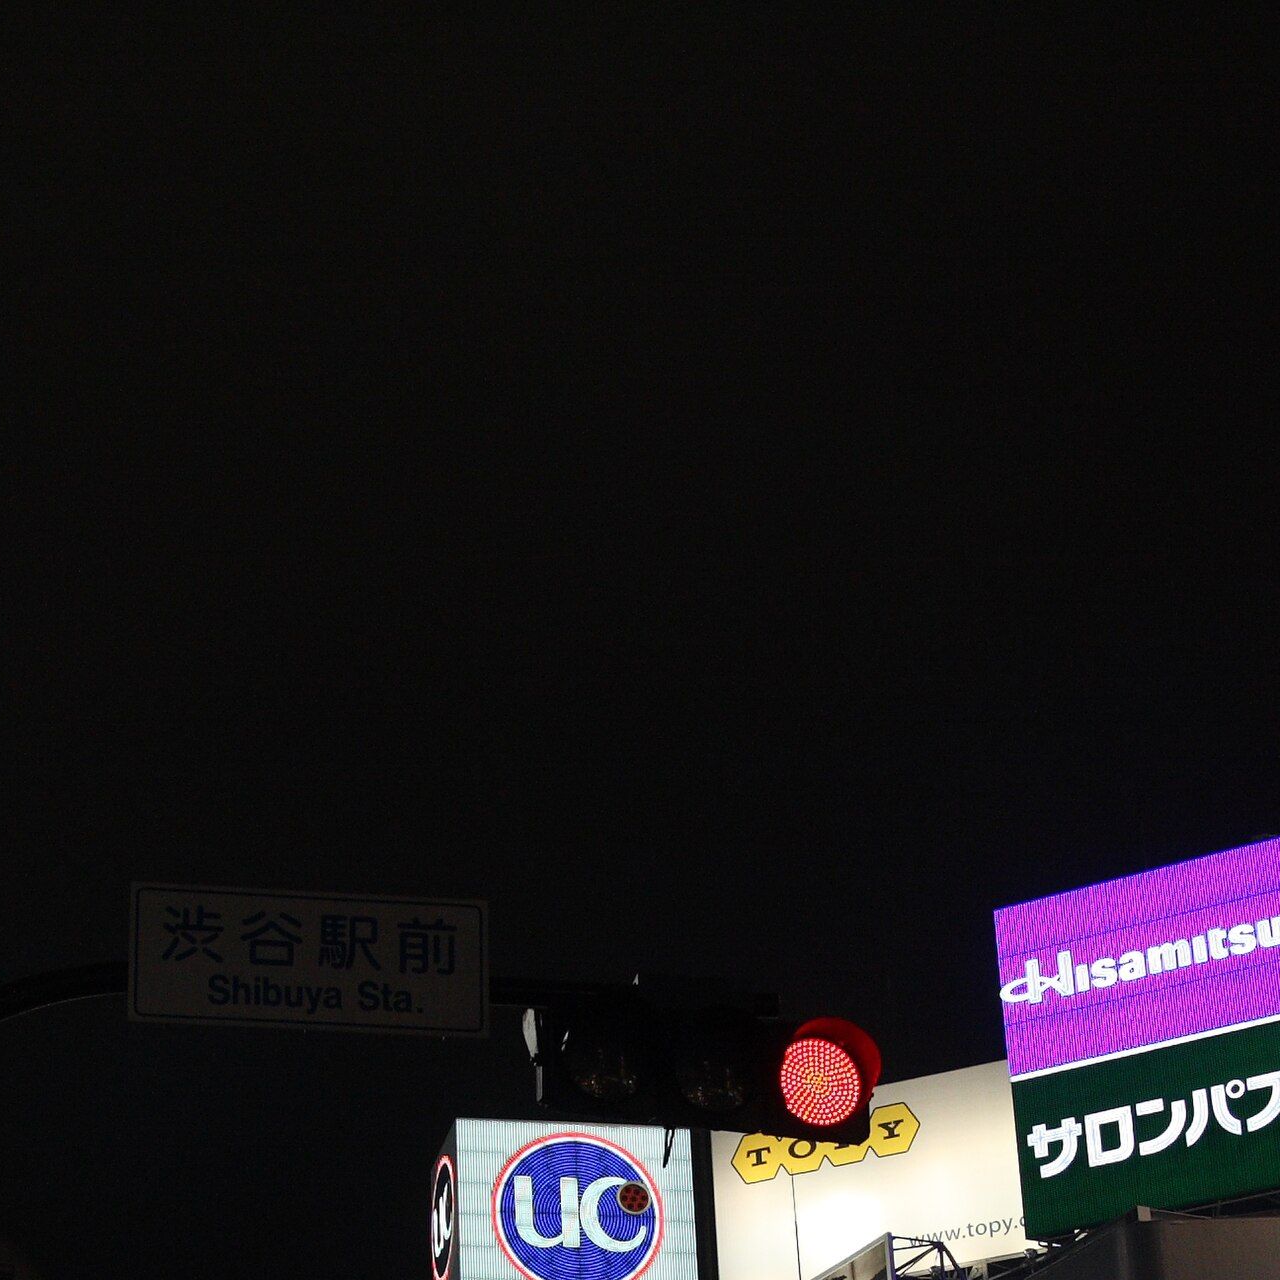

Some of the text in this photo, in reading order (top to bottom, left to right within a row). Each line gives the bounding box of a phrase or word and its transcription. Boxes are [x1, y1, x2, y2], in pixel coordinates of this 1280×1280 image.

[161, 903, 458, 977] 渋谷駅前
[206, 973, 425, 1015] Shibuya Sta.
[747, 1119, 905, 1168] TOY
